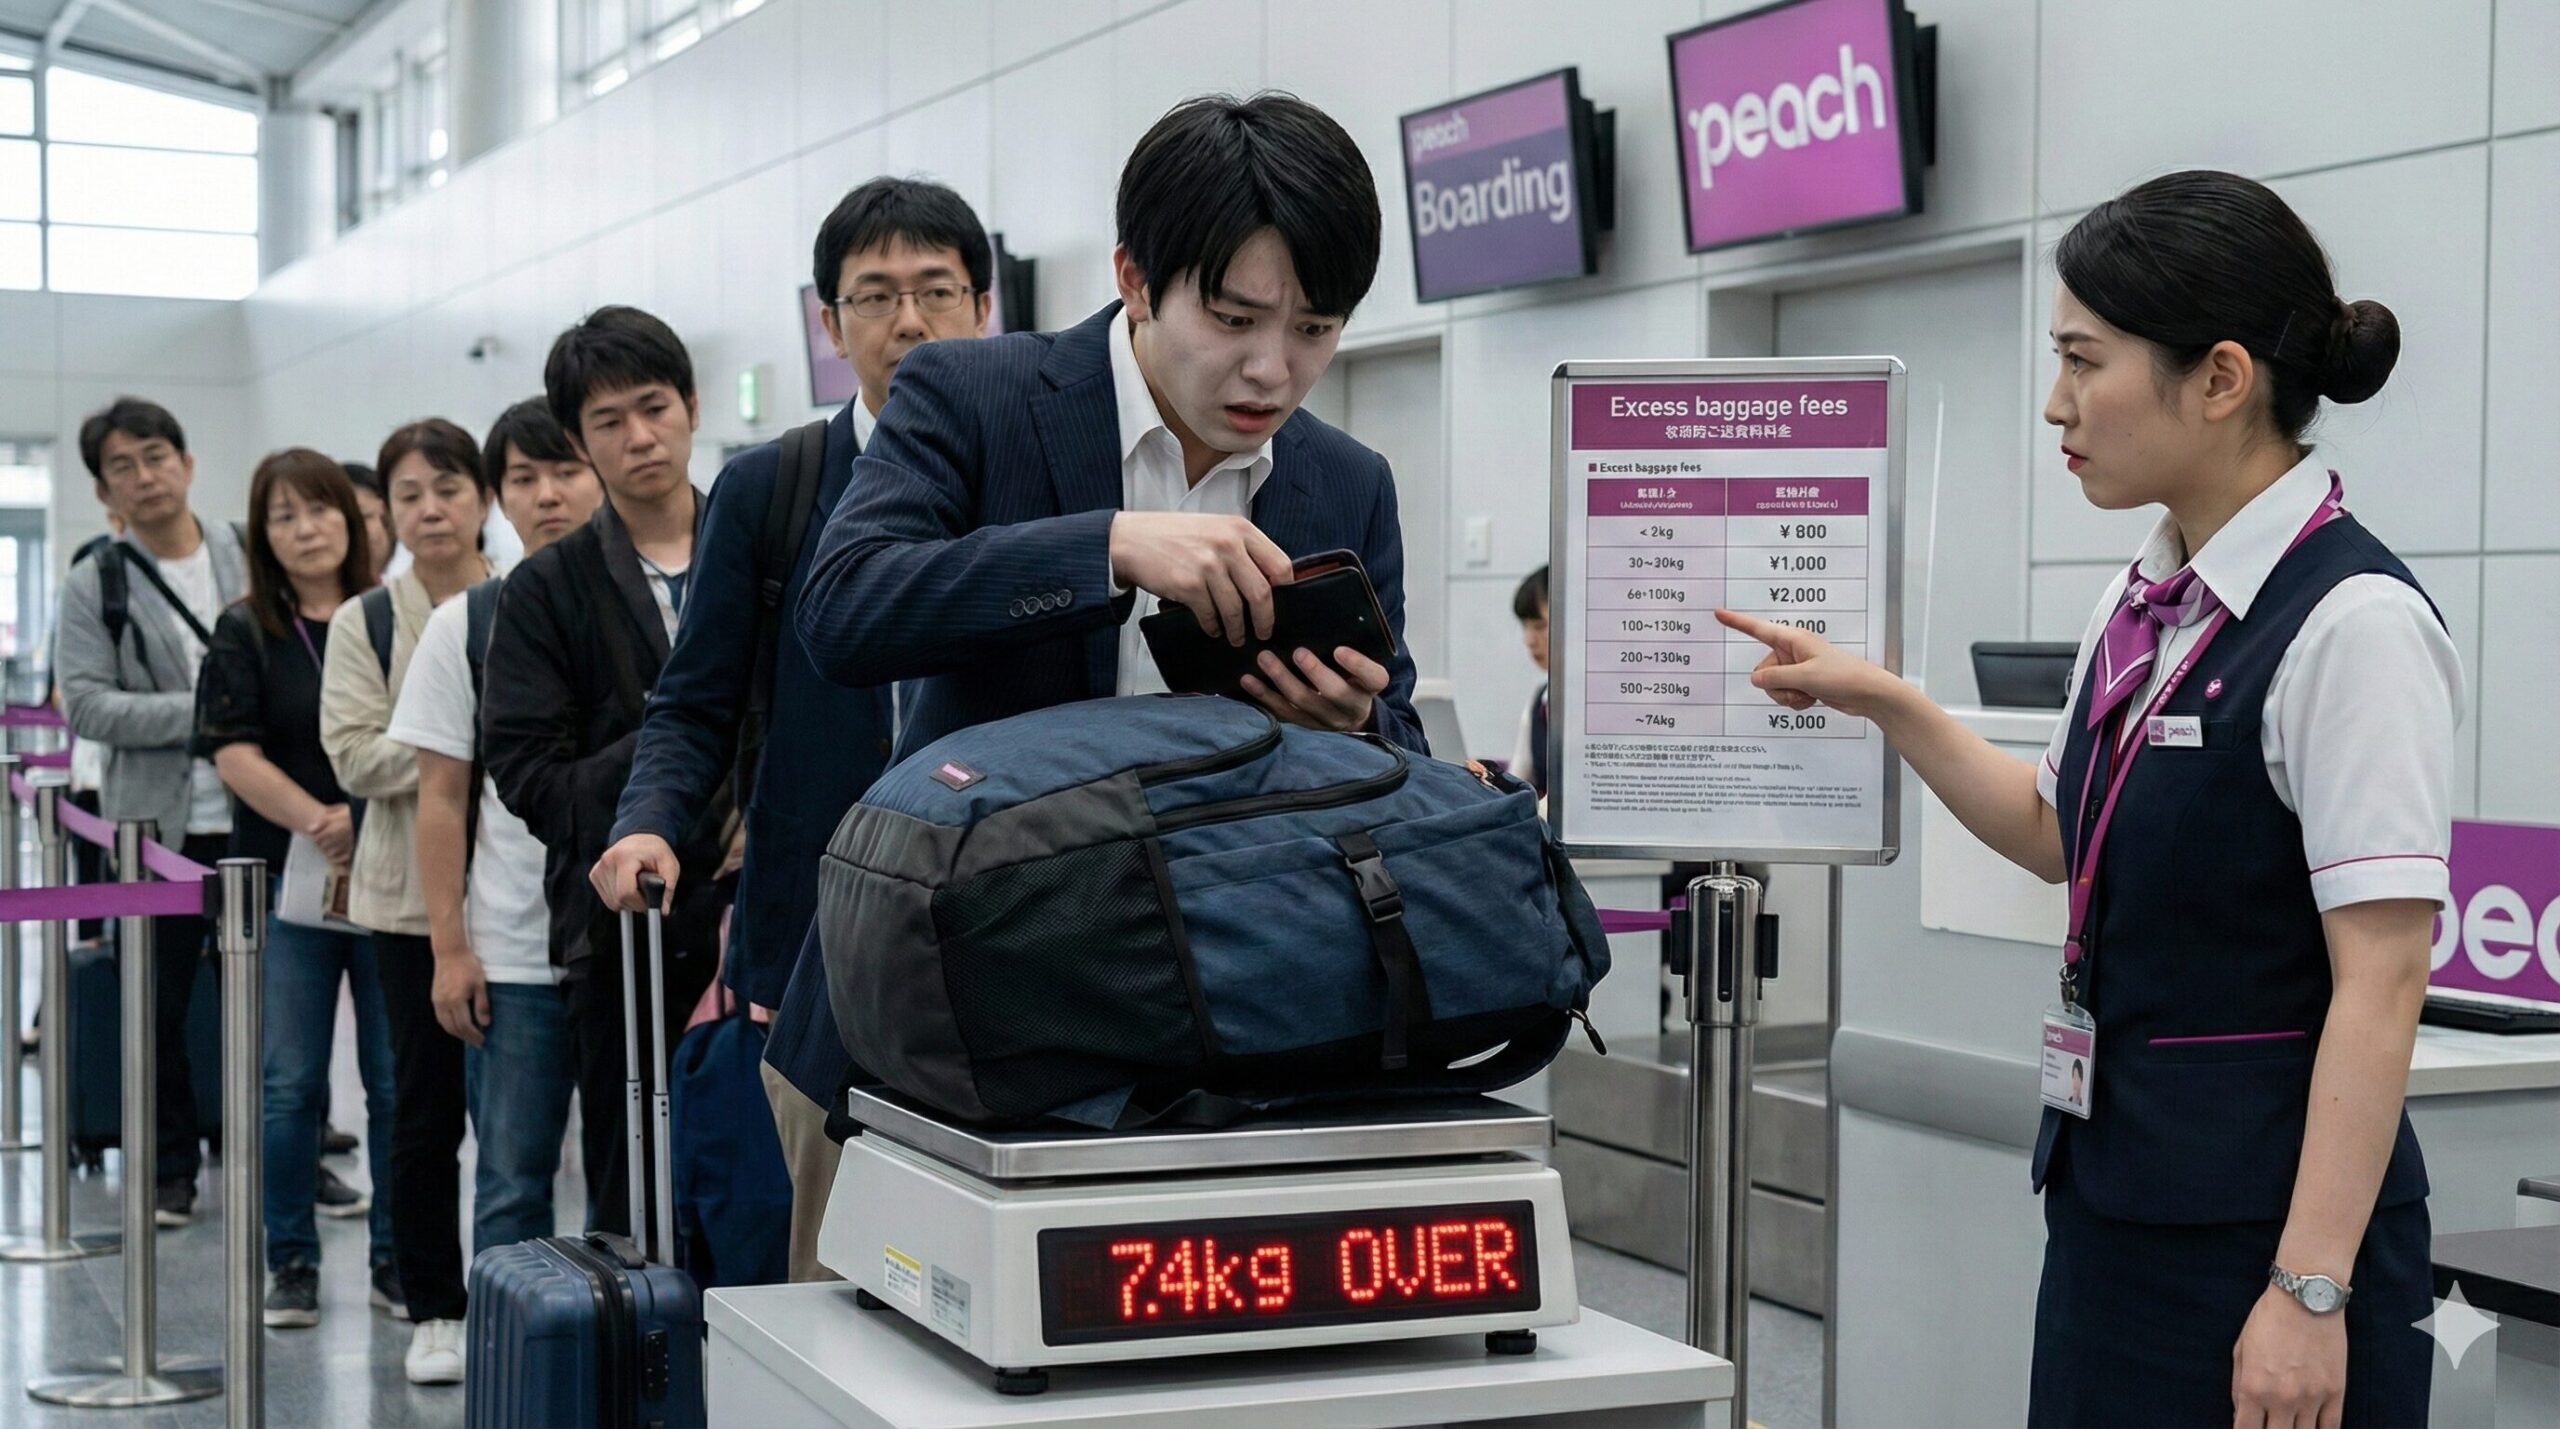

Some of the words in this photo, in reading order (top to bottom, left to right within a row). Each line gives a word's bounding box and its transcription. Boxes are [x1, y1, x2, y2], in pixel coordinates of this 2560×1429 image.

[1688, 44, 1887, 190] peach
[1415, 157, 1571, 237] Boarding
[1611, 396, 1688, 417] Excess
[1695, 396, 1793, 422] baggage
[1799, 395, 1848, 415] fees
[1680, 462, 1702, 472] fees
[1651, 525, 1674, 540] 2kg
[1795, 524, 1827, 539] 800
[1770, 556, 1827, 573] ¥1,000
[1770, 587, 1827, 603] ¥2,000
[1621, 620, 1691, 634] 100~130kg
[1768, 714, 1827, 731] ¥5,000
[1109, 1240, 1293, 1319] 7.4kg
[1339, 1221, 1517, 1301] OVER
